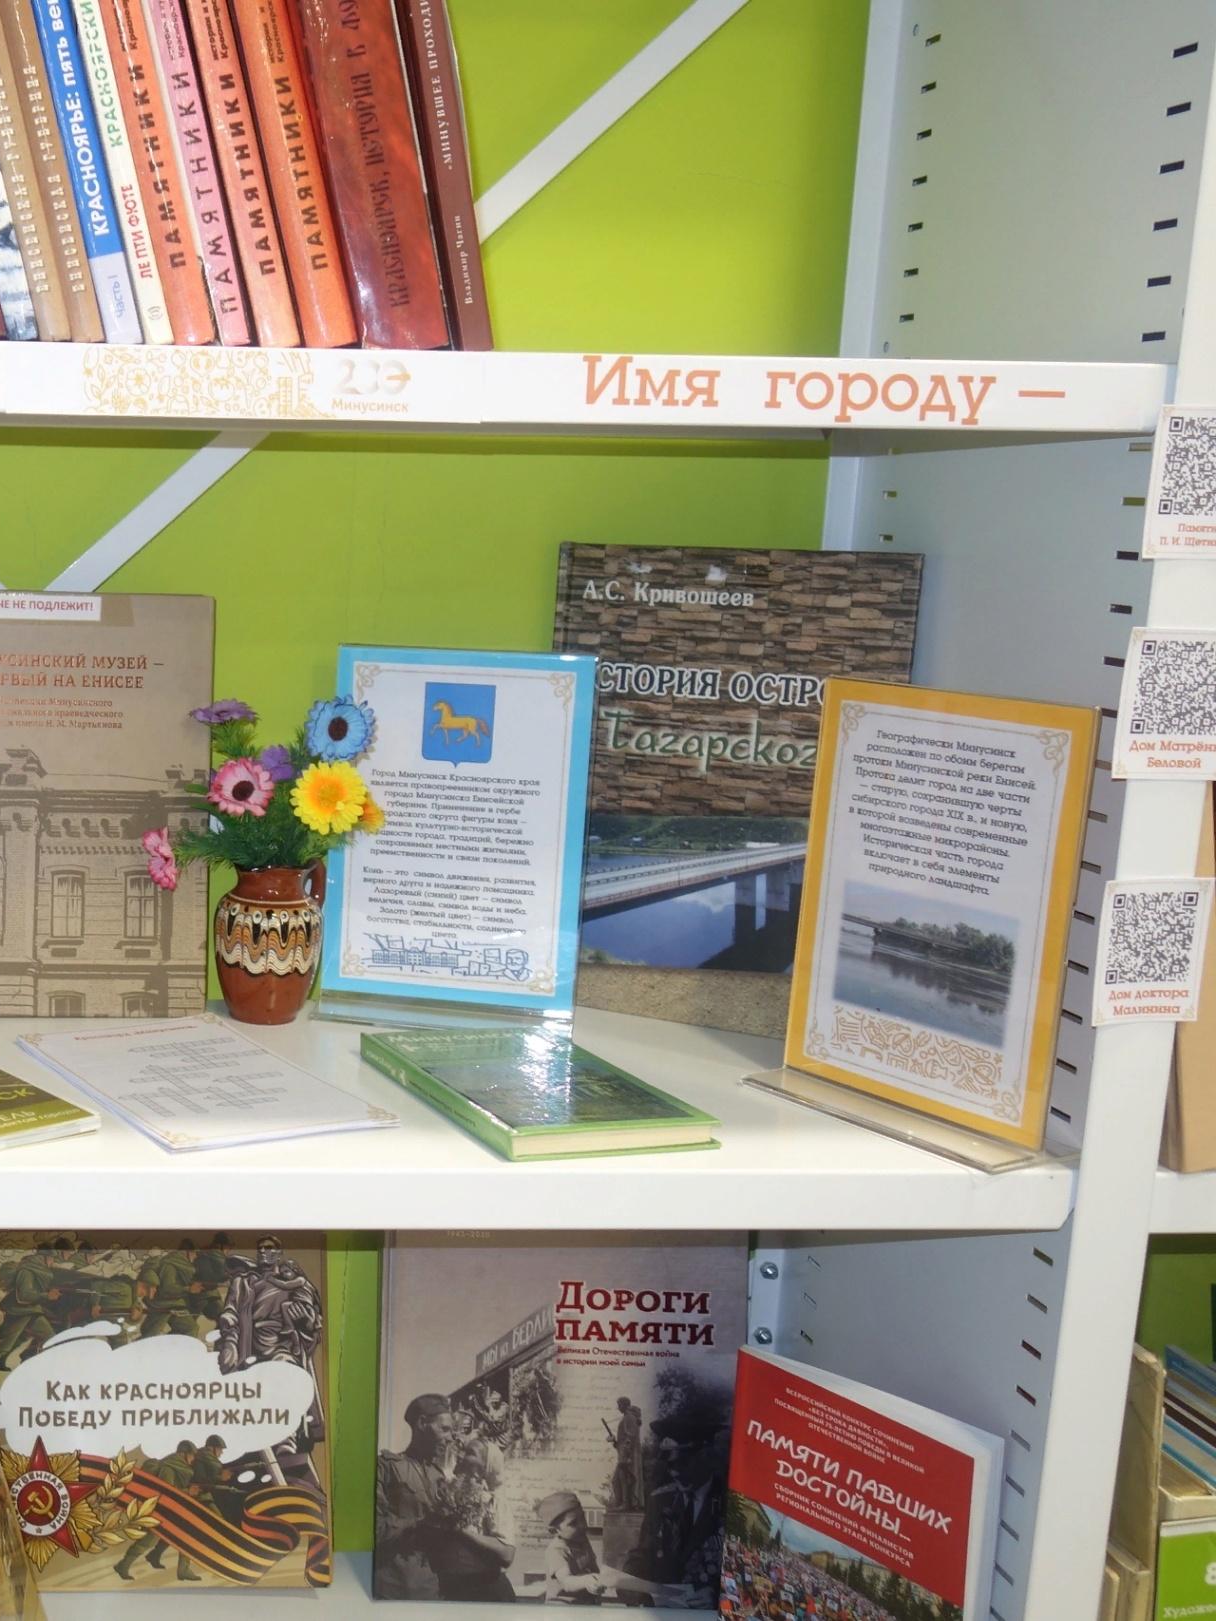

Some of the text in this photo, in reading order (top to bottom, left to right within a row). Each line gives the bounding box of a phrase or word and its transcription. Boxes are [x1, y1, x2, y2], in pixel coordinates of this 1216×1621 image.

[65, 91, 110, 236] КРАСНОЯРЬЕ:
[128, 65, 186, 268] ПАМЯТНИКИ
[219, 73, 276, 275] ПАМЯТНИКИ
[274, 76, 329, 271] ПАМЯТНИКИ
[171, 72, 238, 314] ПАМЯТНИКИ
[121, 184, 154, 278] ЛЕ ПТИ ФЮТЕ
[455, 215, 473, 305] Владимир Чагин
[331, 398, 409, 414] Минусинск
[582, 355, 996, 426] Имя городу
[12, 599, 26, 609] НЕ
[28, 600, 94, 612] ПОДЛЕЖИТ!
[583, 580, 755, 607] А.С. Кривошеев
[91, 654, 148, 670] МУЗЕЙ
[53, 675, 77, 688] НА
[82, 675, 145, 689] ЕНИСЕЕ
[597, 661, 720, 700] СТОРИЯ
[1129, 740, 1156, 752] Дом
[1147, 756, 1201, 769] Беловой
[1108, 988, 1189, 1002] Дом доктора
[1113, 1004, 1180, 1017] Малинина
[554, 1319, 714, 1346] ПАМЯТИ
[747, 1420, 952, 1534] ПАМЯТИ ПАВШИХ
